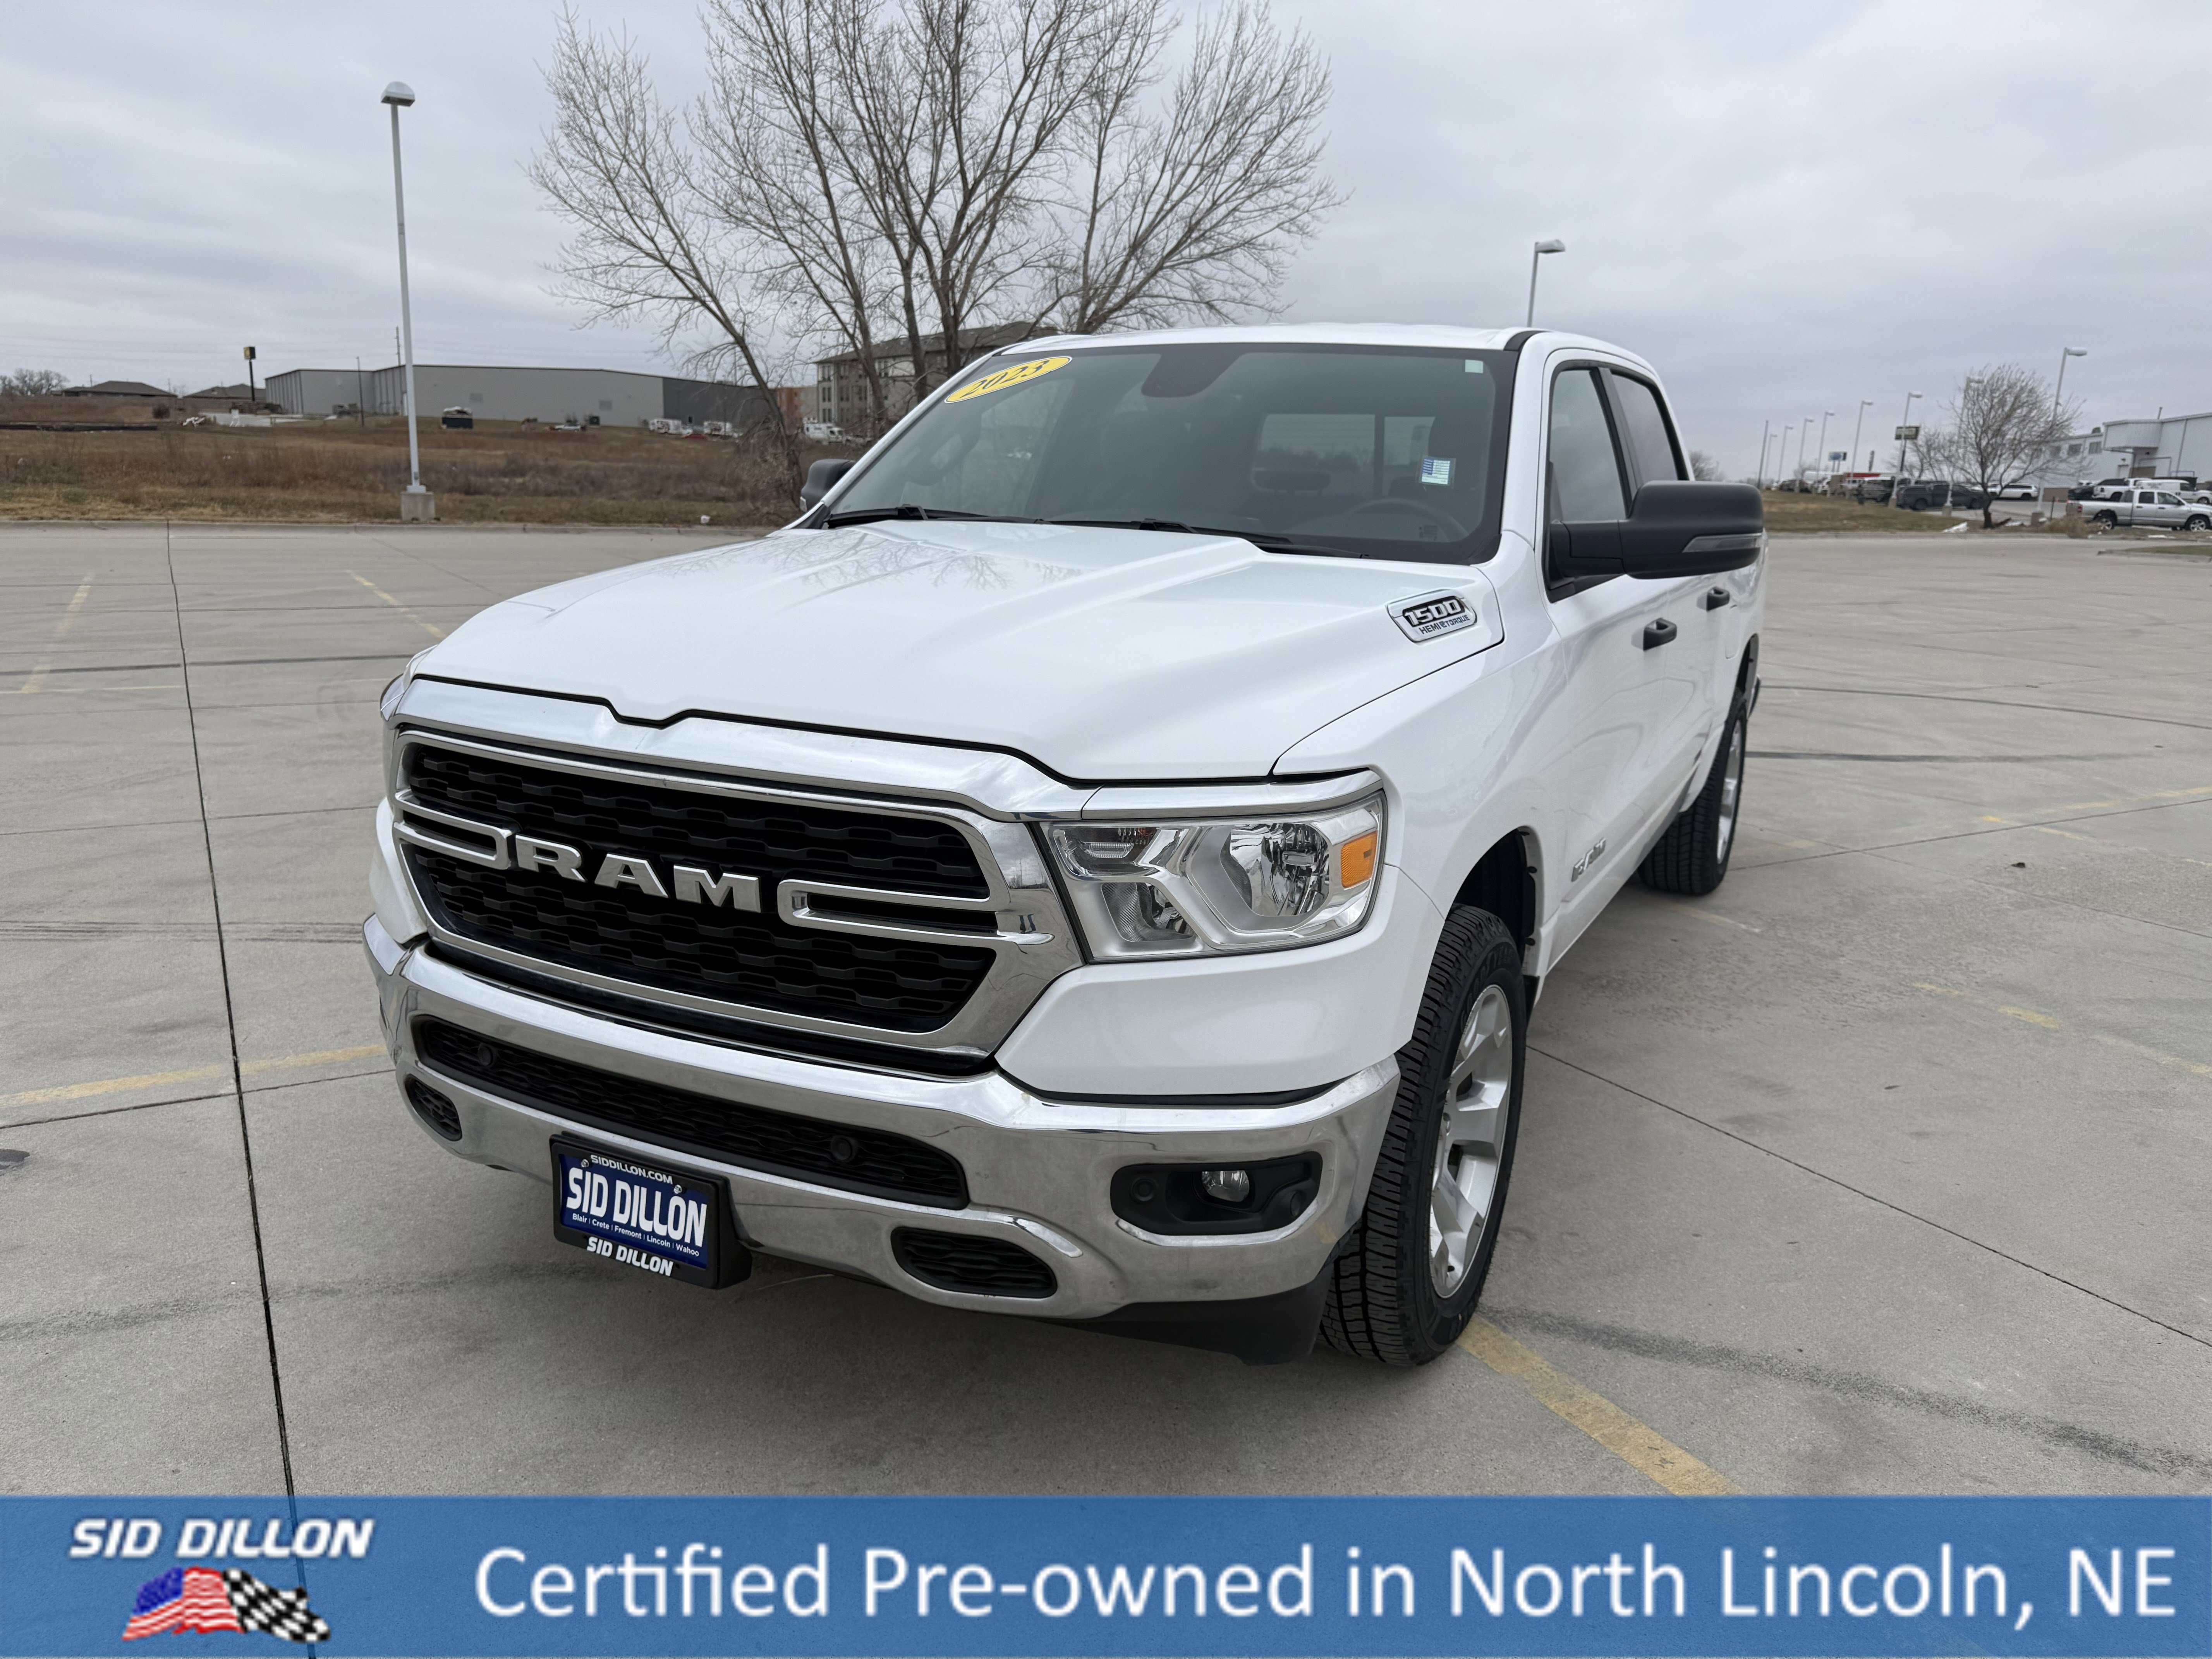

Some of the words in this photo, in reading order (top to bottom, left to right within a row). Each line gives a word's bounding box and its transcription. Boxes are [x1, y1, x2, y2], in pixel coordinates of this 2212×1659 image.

[959, 359, 1050, 398] 2023
[1405, 599, 1462, 625] 1500
[1419, 623, 1441, 634] HEMI
[515, 833, 762, 914] RAM
[590, 1154, 673, 1185] SIDDILLON.COM
[566, 1167, 609, 1218] SID
[613, 1179, 708, 1247] DILLON
[572, 1212, 588, 1224] Blair
[592, 1219, 610, 1230] Crete
[614, 1225, 642, 1240] Fremont
[646, 1235, 671, 1248] Lincoln
[676, 1243, 700, 1257] Wahoo
[586, 1236, 613, 1257] SID
[615, 1245, 674, 1277] DILLON
